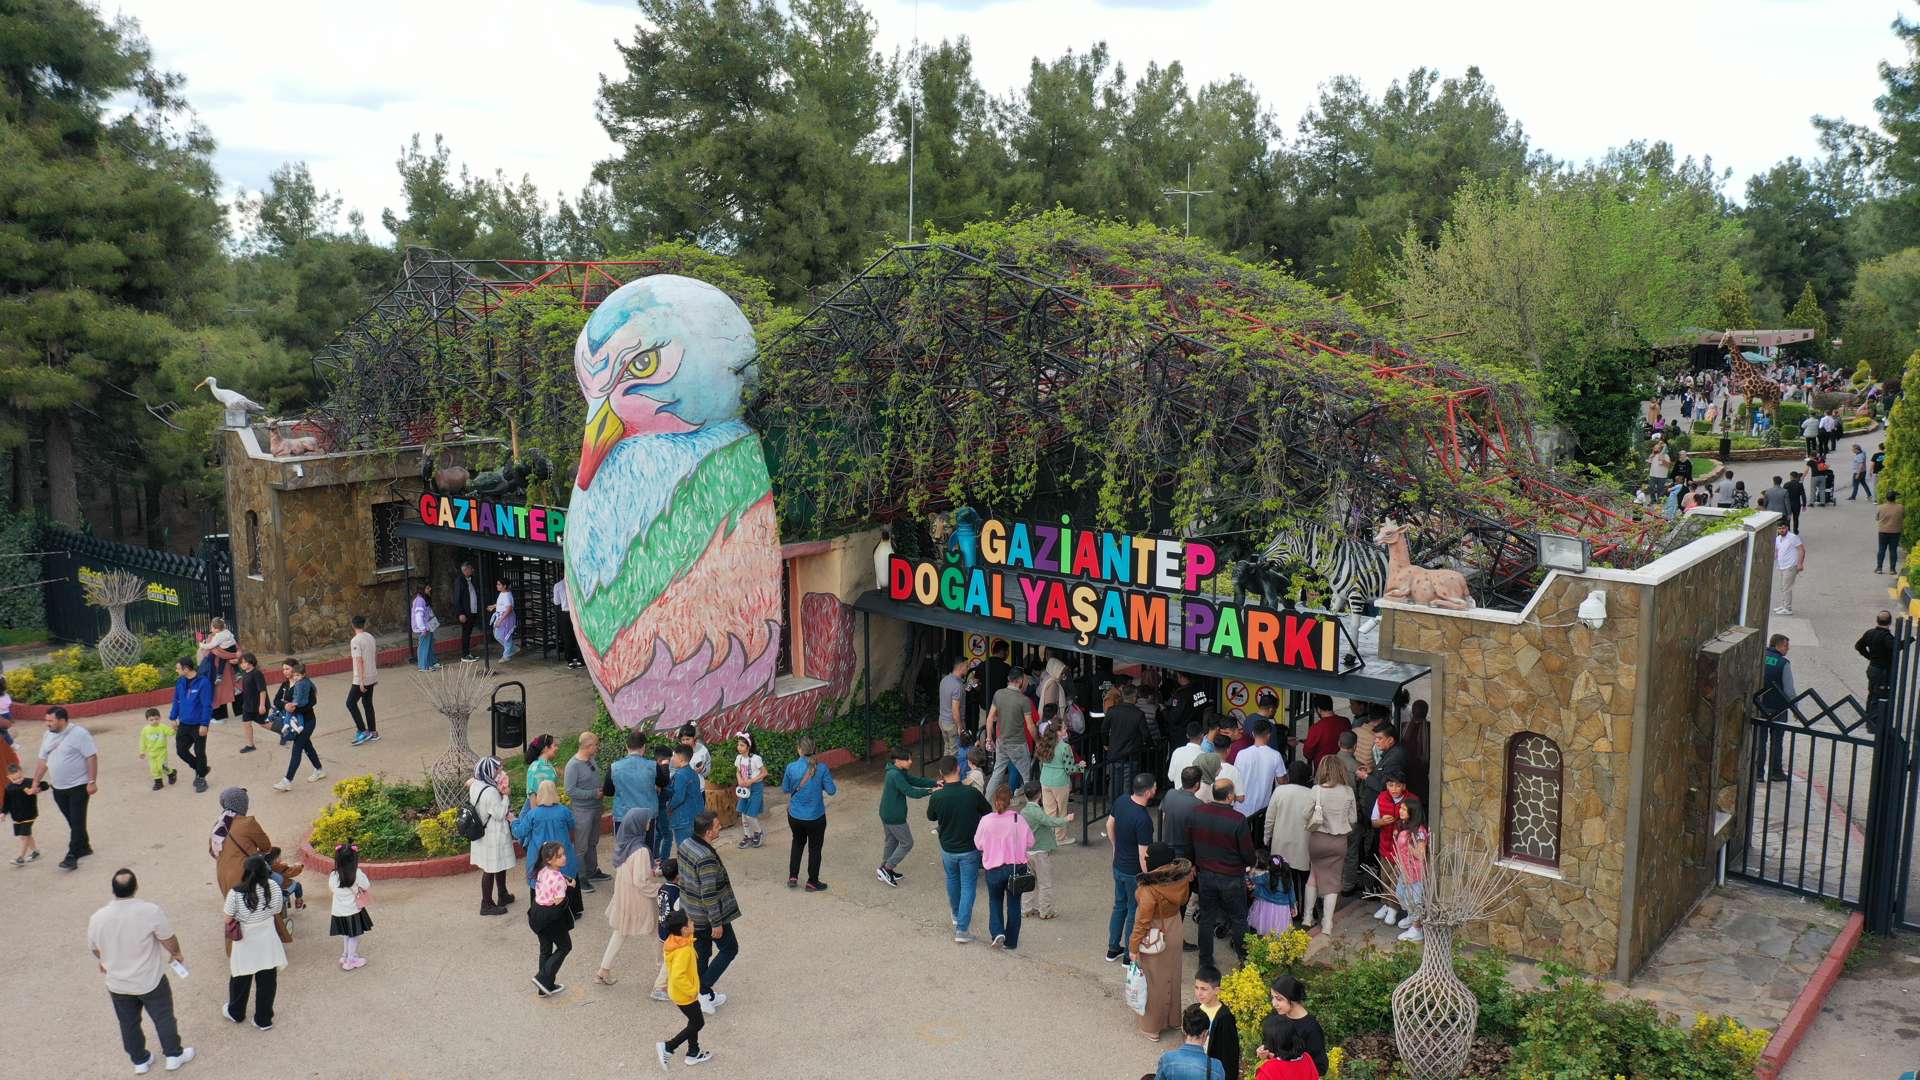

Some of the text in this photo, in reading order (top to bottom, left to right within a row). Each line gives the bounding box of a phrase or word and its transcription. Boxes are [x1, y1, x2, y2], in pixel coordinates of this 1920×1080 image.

[980, 514, 1216, 591] GAZİANTEP
[890, 553, 1335, 672] DOĞAL YAŞAM PARKI
